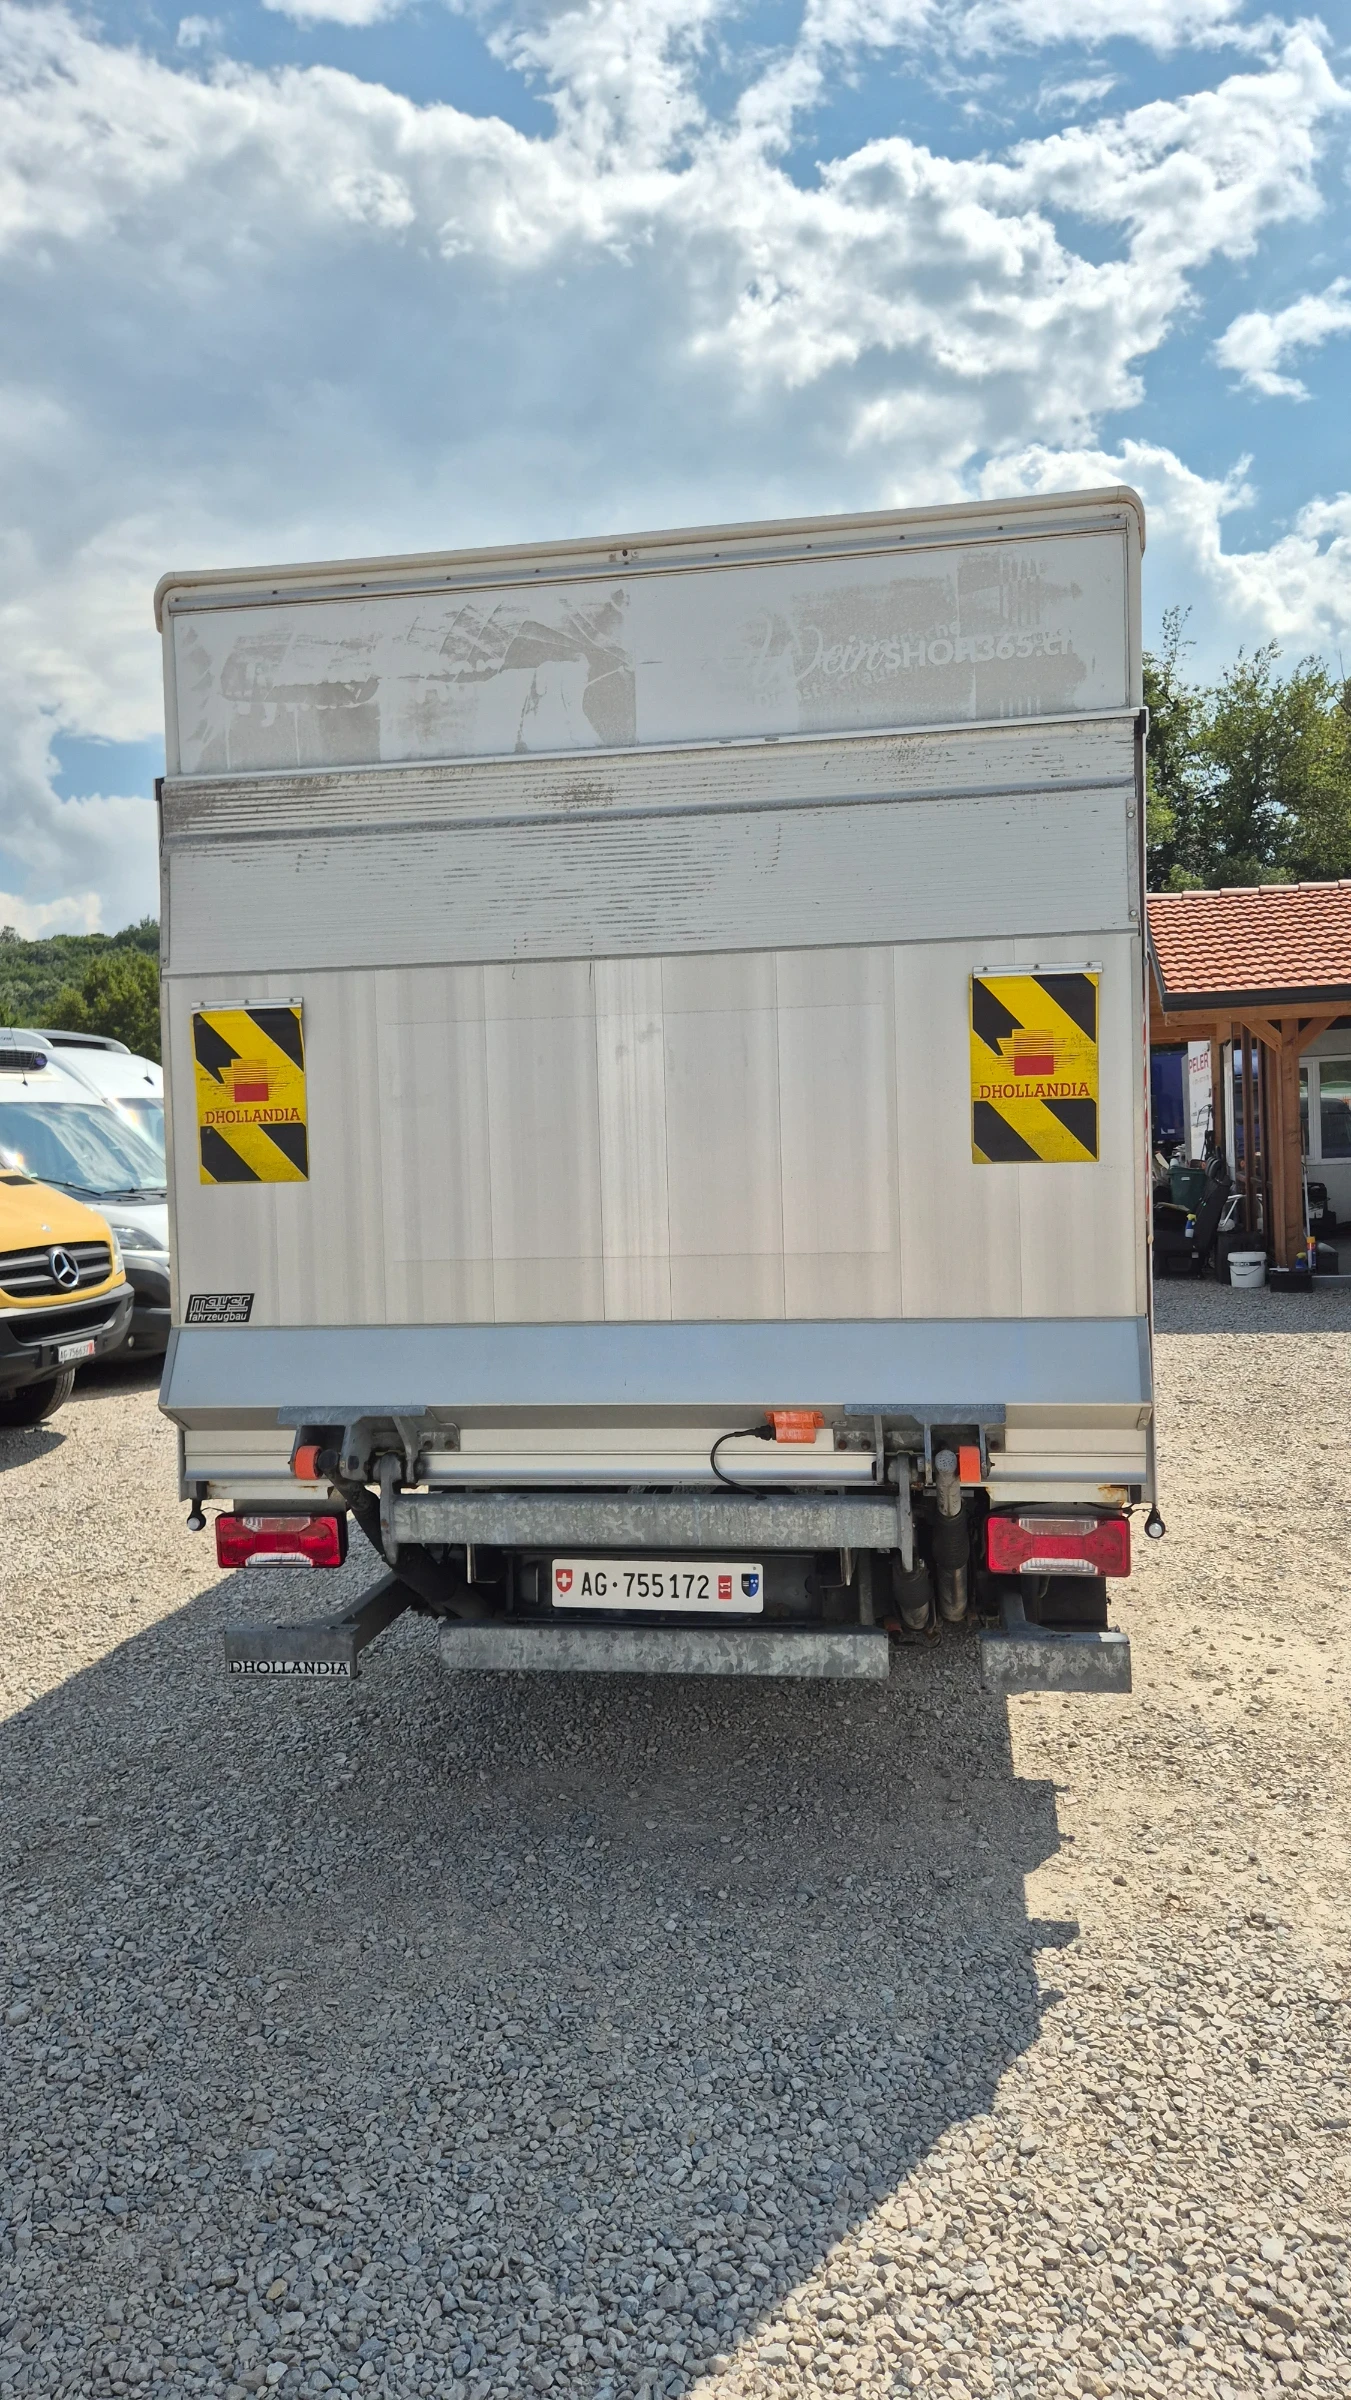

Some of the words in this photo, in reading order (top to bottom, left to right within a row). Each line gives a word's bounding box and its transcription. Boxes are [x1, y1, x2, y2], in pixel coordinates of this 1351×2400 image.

[980, 1082, 1091, 1099] DHOLLANDIA
[205, 1107, 301, 1124] DHOLLANDIA
[190, 1295, 251, 1313] mayer
[188, 1312, 247, 1322] fahrzeugbau
[228, 1660, 349, 1675] DHOLLANDIA
